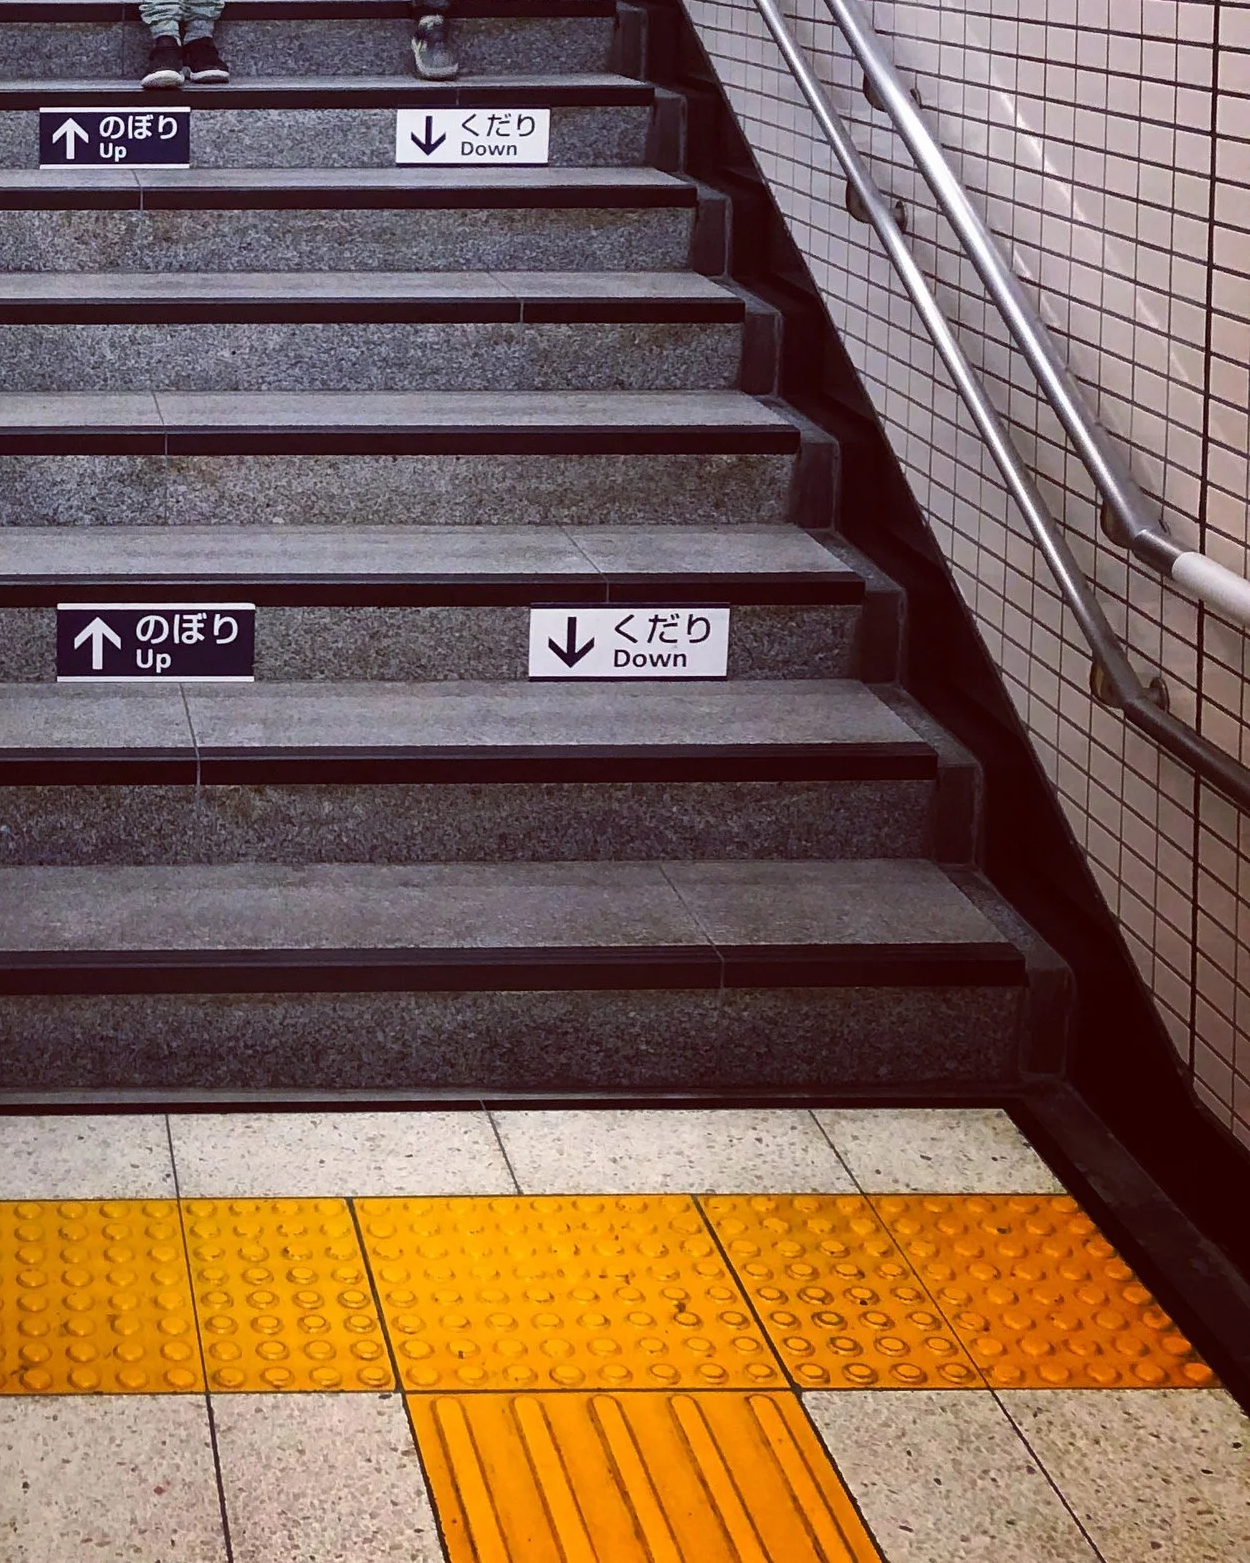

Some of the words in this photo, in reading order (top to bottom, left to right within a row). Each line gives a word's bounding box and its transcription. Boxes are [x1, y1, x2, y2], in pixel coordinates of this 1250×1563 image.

[99, 114, 177, 139] のぼり
[461, 114, 535, 137] くだり
[100, 143, 127, 162] Up
[461, 141, 518, 156] Down
[136, 613, 238, 644] のぼり
[614, 613, 711, 644] くだり
[136, 648, 172, 673] Up
[614, 649, 687, 668] Down
